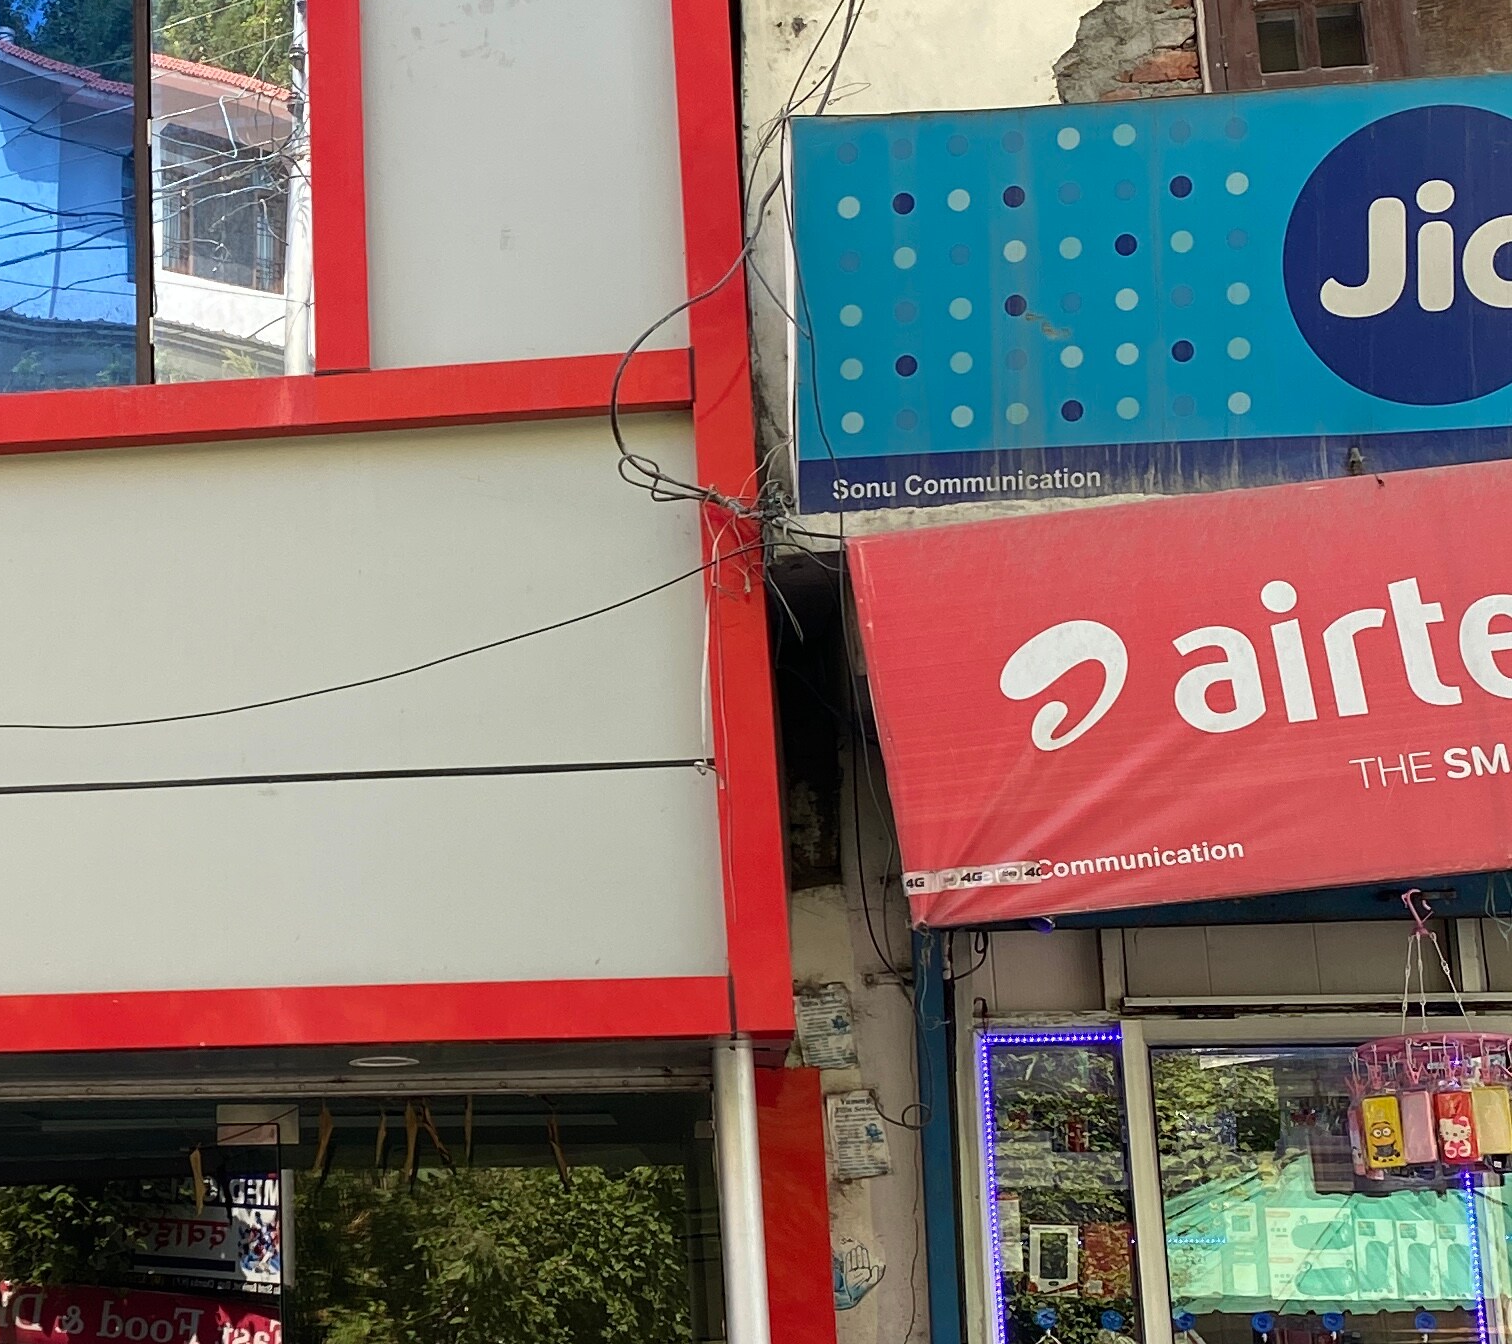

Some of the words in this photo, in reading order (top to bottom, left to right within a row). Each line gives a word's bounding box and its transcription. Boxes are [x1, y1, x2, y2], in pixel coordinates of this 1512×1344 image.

[832, 478, 896, 500] Sonu
[904, 468, 1101, 496] Communication
[1349, 751, 1436, 789] THE
[1038, 841, 1245, 881] Communication
